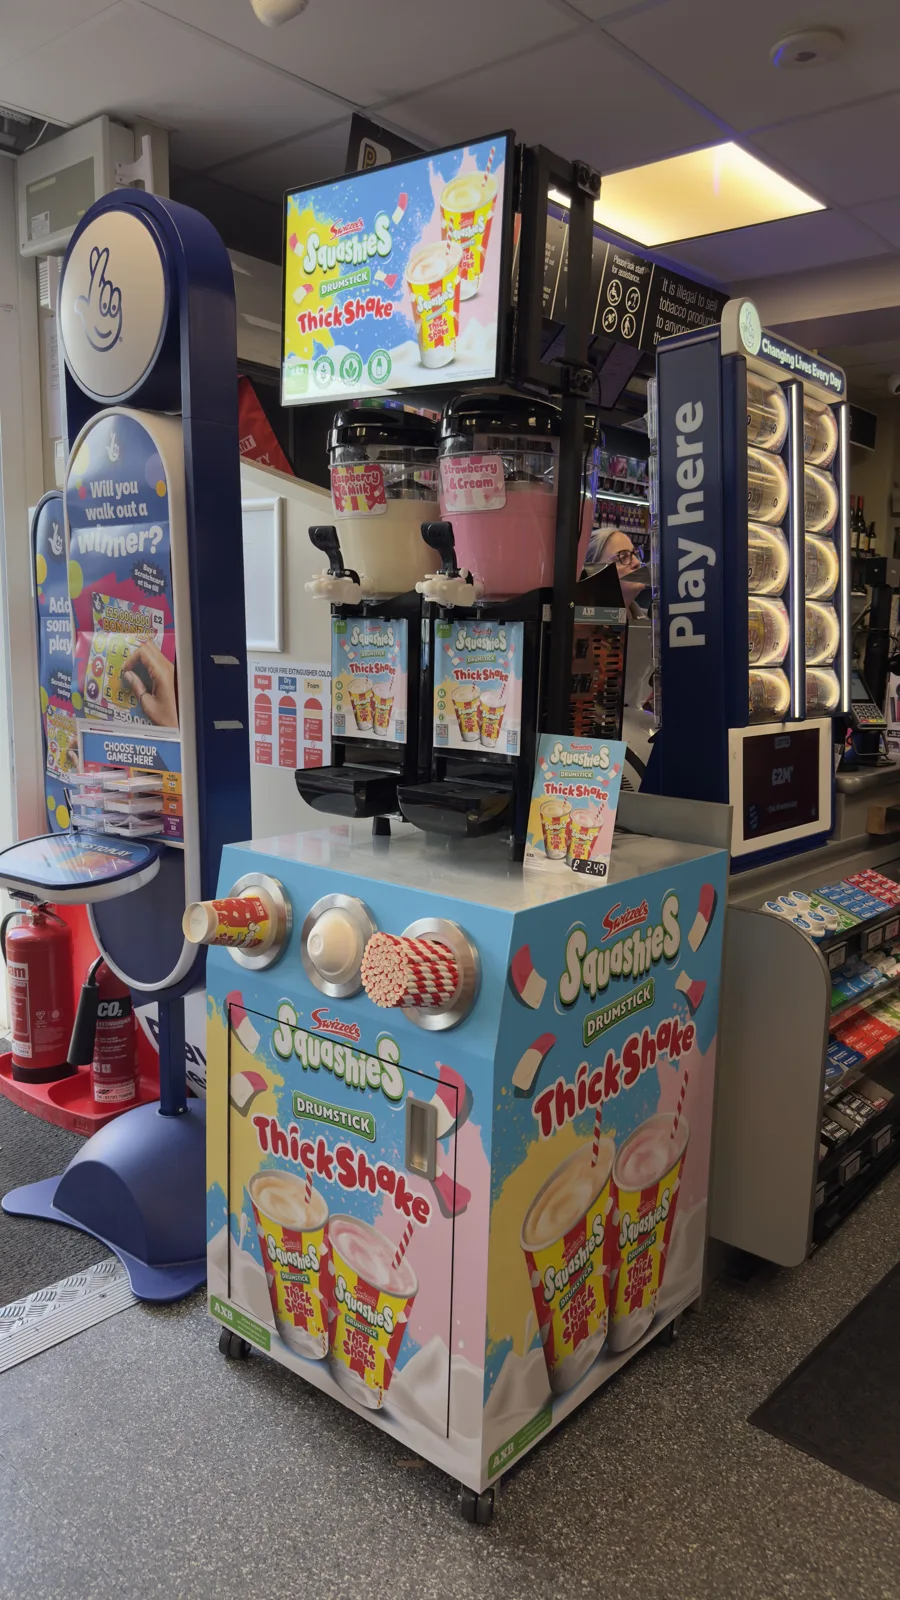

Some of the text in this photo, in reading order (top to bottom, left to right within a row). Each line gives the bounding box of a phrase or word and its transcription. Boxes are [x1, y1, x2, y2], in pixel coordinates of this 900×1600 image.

[627, 261, 635, 271] ask
[635, 264, 645, 275] staff
[321, 271, 368, 294] DRUMSTICK
[662, 278, 719, 312] It is illegal to sell
[659, 296, 687, 318] tobacco
[656, 314, 663, 328] to
[761, 338, 842, 391] Changing Lives Every Day
[332, 471, 380, 486] Raspberry
[444, 463, 498, 475] Strawberry
[90, 480, 138, 500] Will you
[85, 501, 148, 520] walk out a
[667, 401, 717, 648] Play here
[77, 524, 163, 558] winner?
[46, 619, 72, 632] som
[153, 614, 162, 625] £2
[49, 635, 72, 655] play
[283, 677, 291, 685] Dry
[288, 668, 317, 676] EXTINGUISHER
[318, 670, 332, 678] COLO
[104, 741, 156, 756] CHOOSE YOUR
[107, 752, 153, 766] GAMES HERE
[560, 771, 593, 779] DRUMSTICK
[585, 861, 605, 875] 2.49
[601, 899, 650, 942] Swizzels
[8, 966, 26, 978] am
[587, 989, 651, 1037] DRUMSTICK
[311, 1008, 361, 1042] Swizzels
[297, 1096, 370, 1134] DRUMSTICK
[281, 1273, 309, 1282] DRUMSTICK
[627, 1254, 653, 1283] Thick
[284, 1285, 311, 1306] Thick
[561, 1266, 592, 1307] DRUMSTICK
[623, 1271, 653, 1303] Shake
[214, 1302, 233, 1321] AXB
[284, 1299, 315, 1317] Shake
[562, 1284, 595, 1325] Thick
[346, 1316, 377, 1338] DRUMSTICK
[562, 1298, 597, 1345] Shake
[345, 1327, 376, 1360] Thick
[343, 1340, 376, 1371] Shake
[492, 1442, 514, 1469] AXB
